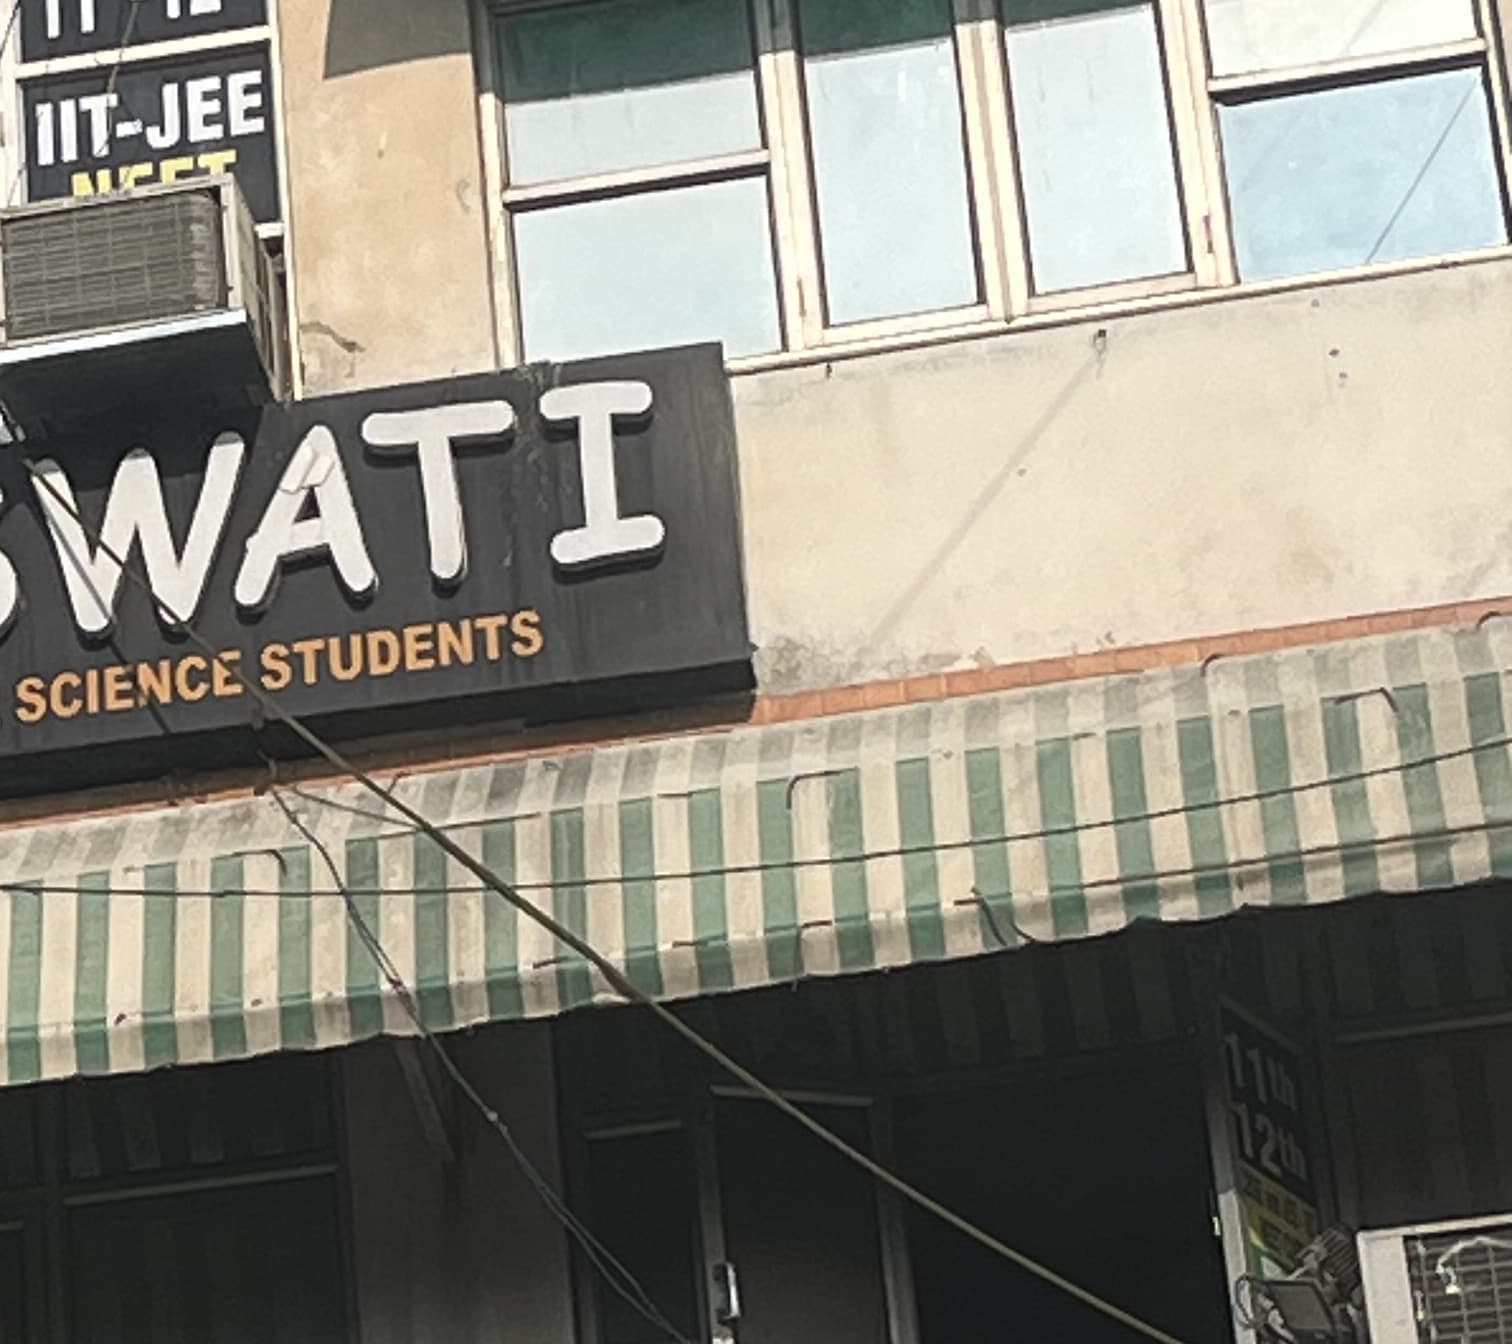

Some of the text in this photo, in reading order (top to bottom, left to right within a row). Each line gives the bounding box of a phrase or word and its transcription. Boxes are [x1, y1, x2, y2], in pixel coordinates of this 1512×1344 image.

[36, 70, 266, 166] IIT-JEE
[16, 648, 245, 724] SCIENCE
[260, 609, 545, 691] STUDENTS
